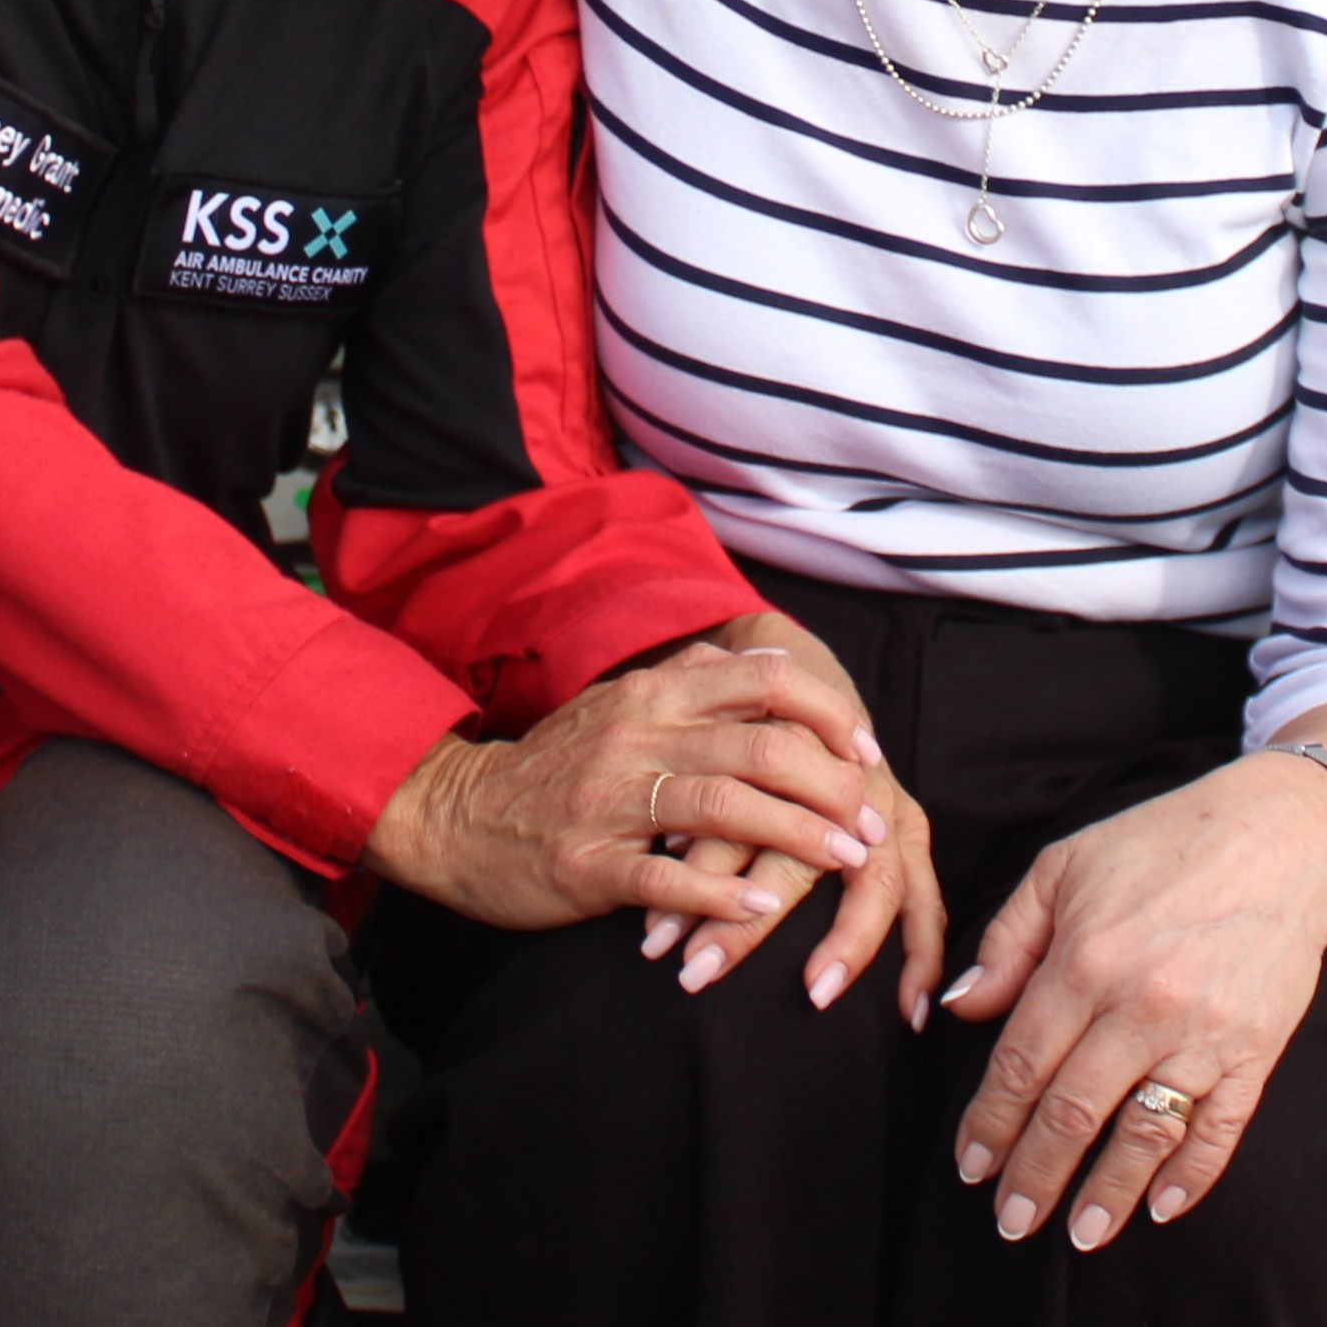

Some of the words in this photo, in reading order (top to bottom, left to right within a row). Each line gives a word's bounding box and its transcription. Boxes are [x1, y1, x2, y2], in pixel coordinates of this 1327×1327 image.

[182, 189, 295, 255] KSS
[174, 250, 205, 269] AIR
[206, 254, 310, 283] AMBULANCE
[312, 266, 368, 284] CHARITY
[169, 270, 215, 289] KENT
[216, 276, 277, 298] SURREY
[278, 284, 333, 301] SUSSEX
